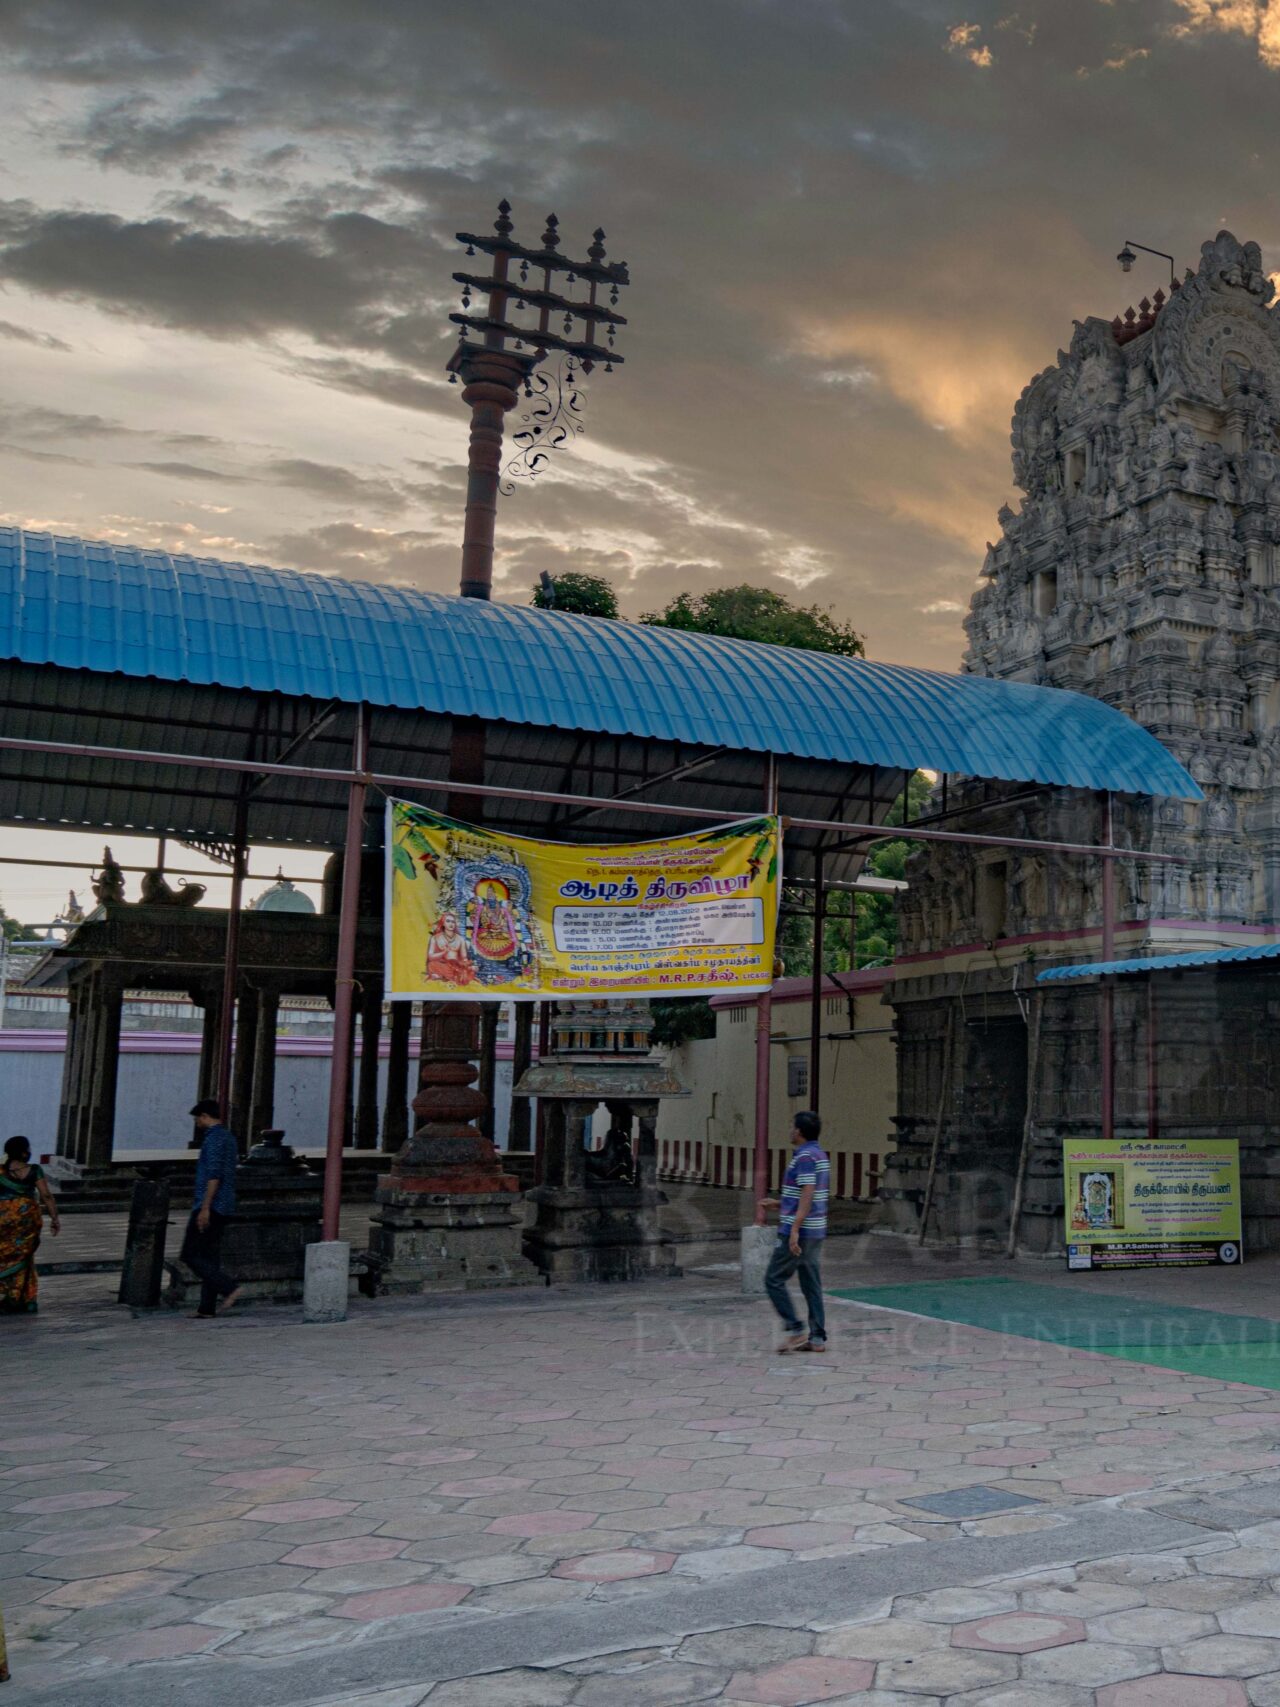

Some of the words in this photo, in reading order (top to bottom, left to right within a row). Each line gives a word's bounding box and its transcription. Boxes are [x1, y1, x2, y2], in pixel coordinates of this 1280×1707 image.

[559, 876, 640, 900] ஆடித்
[645, 874, 751, 900] திருவிழா
[1133, 1183, 1190, 1197] திருக்கோயில்
[1191, 1183, 1231, 1197] திருப்பணி
